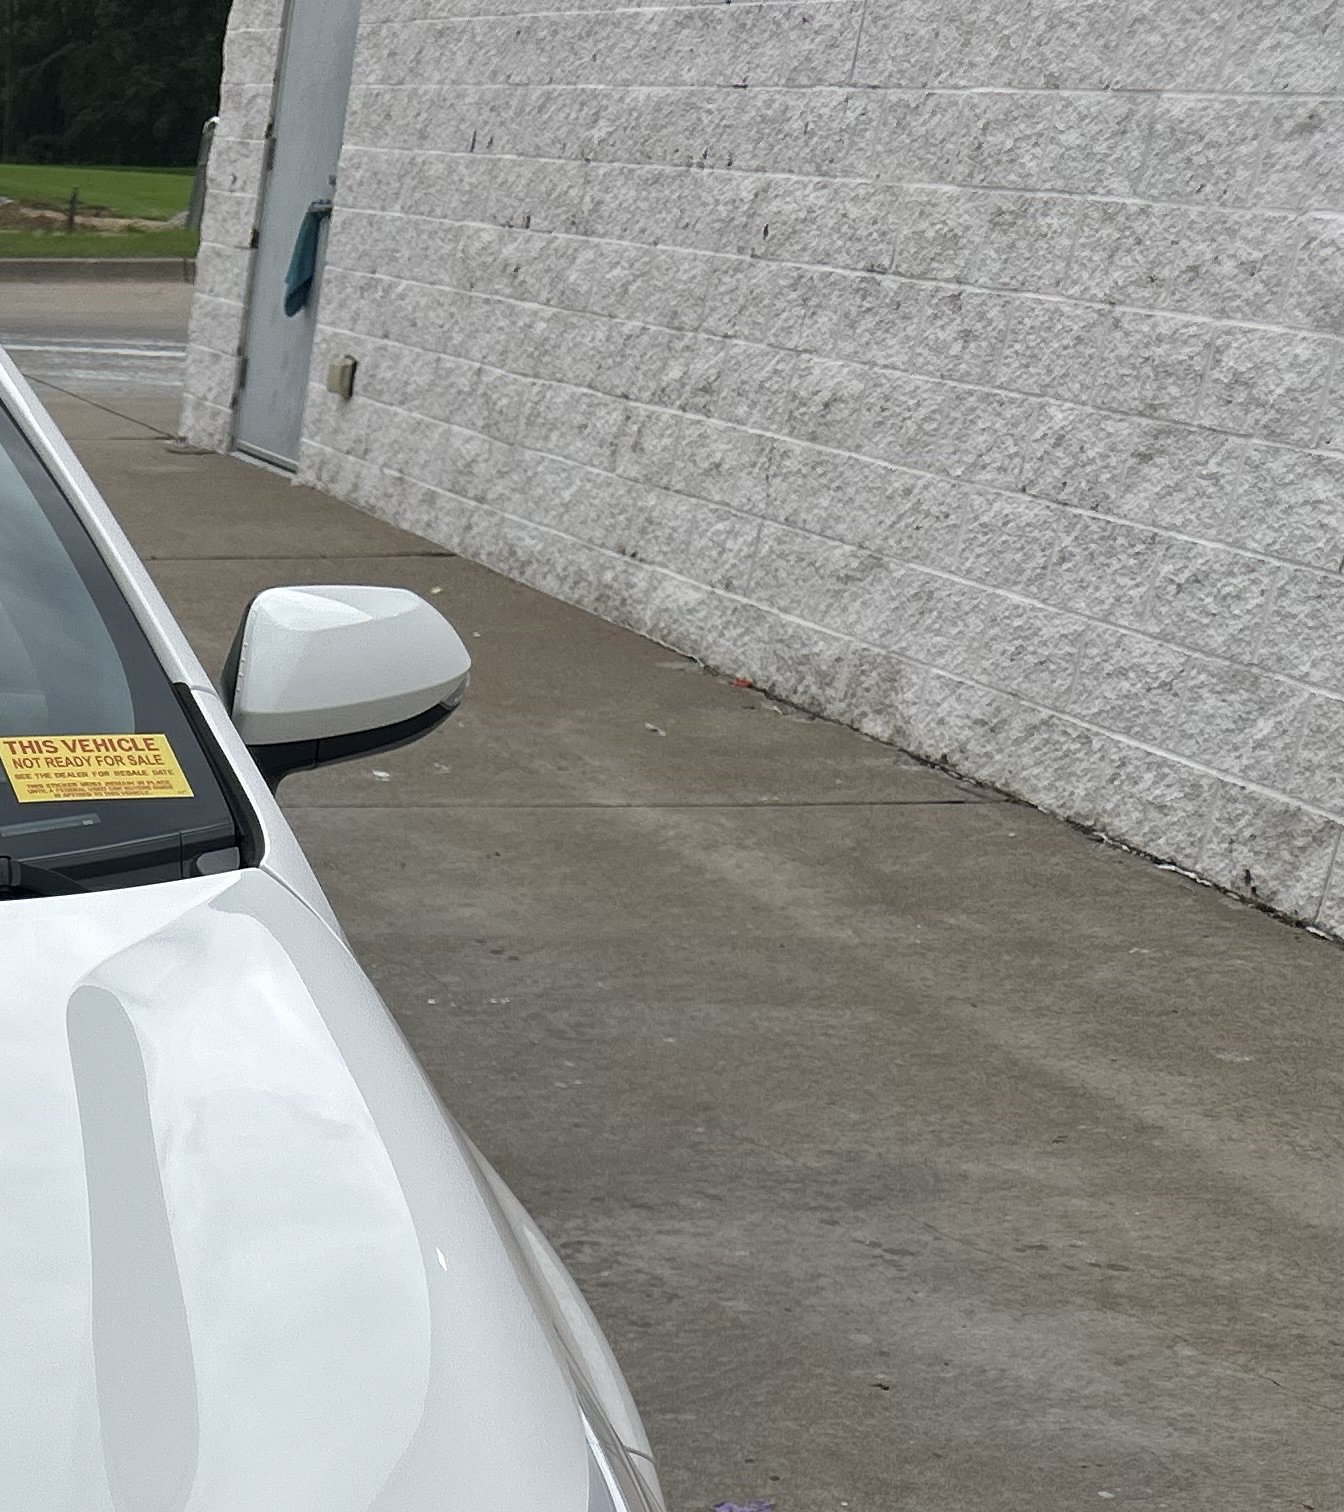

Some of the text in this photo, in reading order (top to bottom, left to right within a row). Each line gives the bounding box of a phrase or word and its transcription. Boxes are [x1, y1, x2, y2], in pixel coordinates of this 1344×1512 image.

[2, 737, 160, 755] THIS VEHICLE
[12, 754, 165, 769] NOT READY FOR SALE
